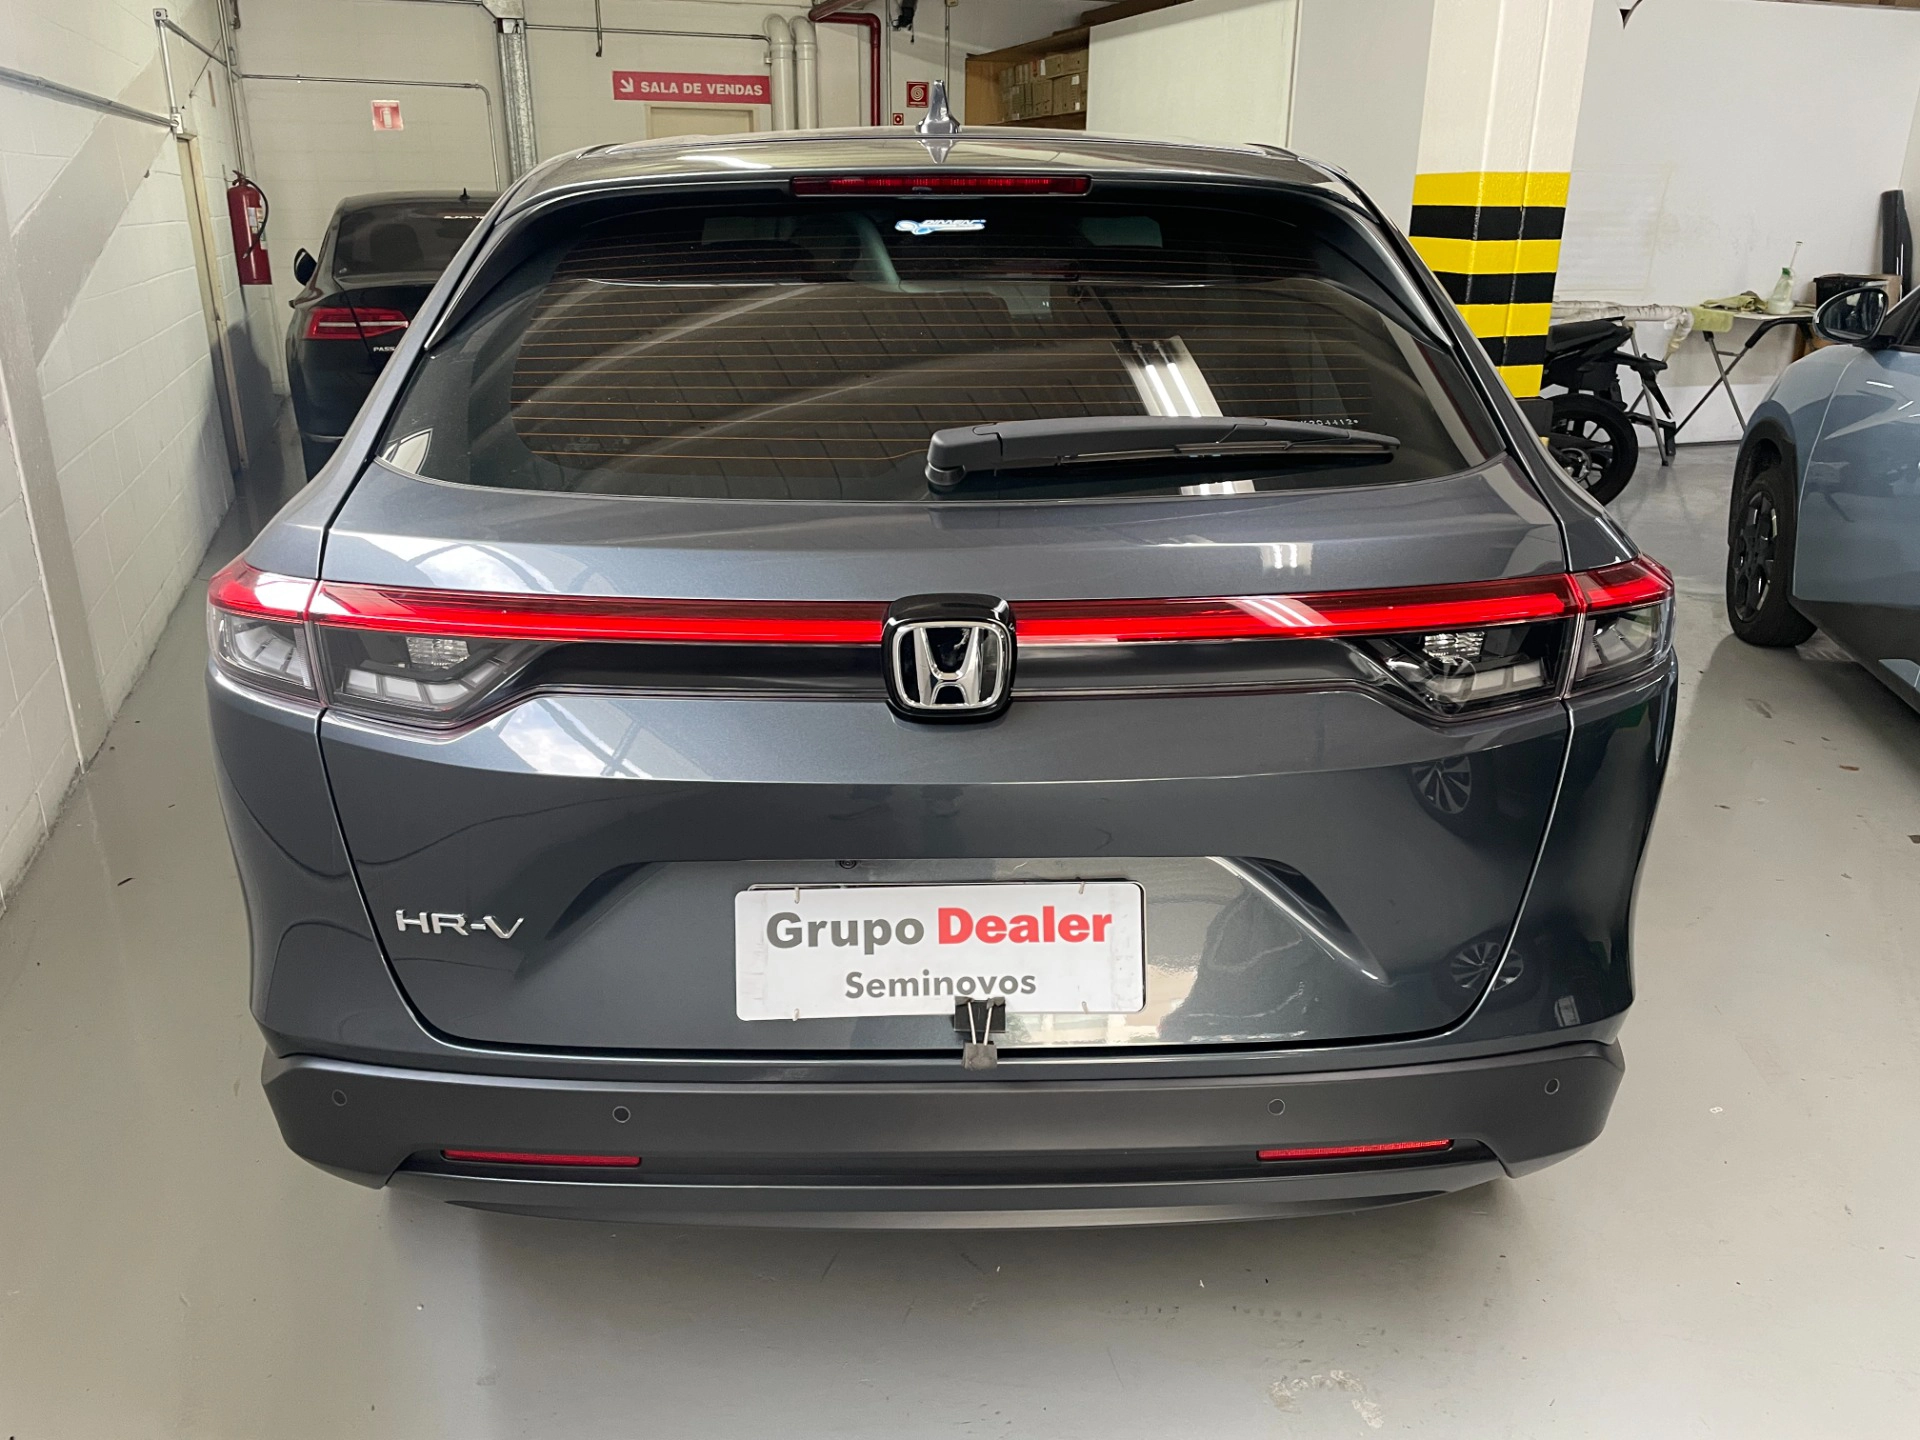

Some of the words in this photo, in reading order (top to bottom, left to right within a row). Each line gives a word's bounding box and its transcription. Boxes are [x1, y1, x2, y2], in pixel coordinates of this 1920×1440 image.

[640, 81, 679, 94] SALA
[683, 82, 702, 94] DE
[706, 83, 763, 96] VENDAS
[395, 909, 525, 939] HR-V
[766, 911, 925, 955] Grupo
[937, 905, 1113, 945] Dealer
[844, 968, 1037, 999] Seminovos
